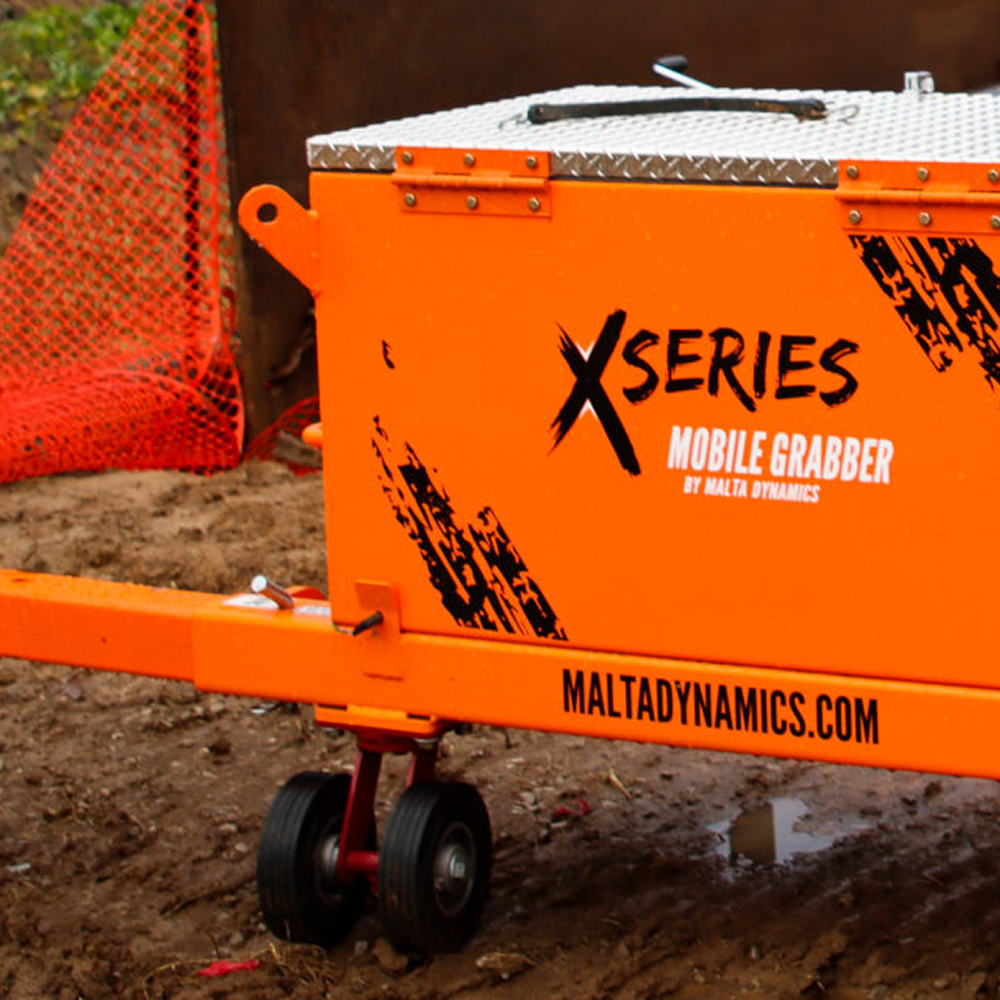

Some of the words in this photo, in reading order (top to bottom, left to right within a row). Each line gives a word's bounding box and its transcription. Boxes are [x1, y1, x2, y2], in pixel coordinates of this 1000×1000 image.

[667, 425, 767, 475] MOBILE
[769, 432, 894, 484] GRABBER
[683, 475, 702, 495] BY
[704, 476, 748, 499] MALTA
[751, 480, 820, 503] DYNAMICS
[563, 668, 880, 745] MALTADYNAMICS.COM
